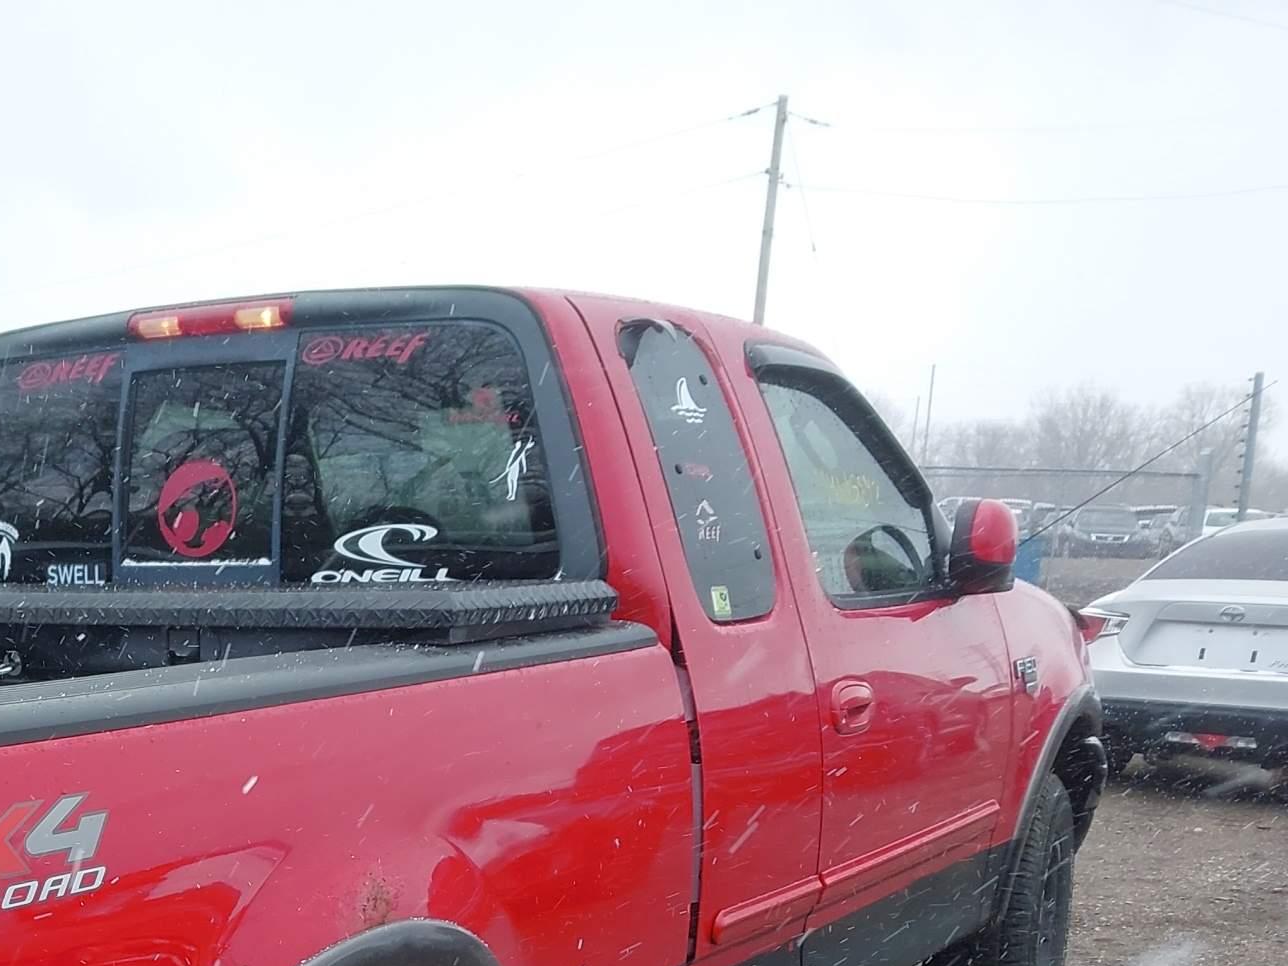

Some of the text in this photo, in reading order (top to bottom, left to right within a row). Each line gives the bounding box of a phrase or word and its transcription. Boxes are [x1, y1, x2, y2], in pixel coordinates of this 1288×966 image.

[340, 331, 430, 364] REEF
[697, 524, 722, 544] REEF
[46, 563, 106, 586] SWELL
[310, 567, 462, 584] O'NEILL
